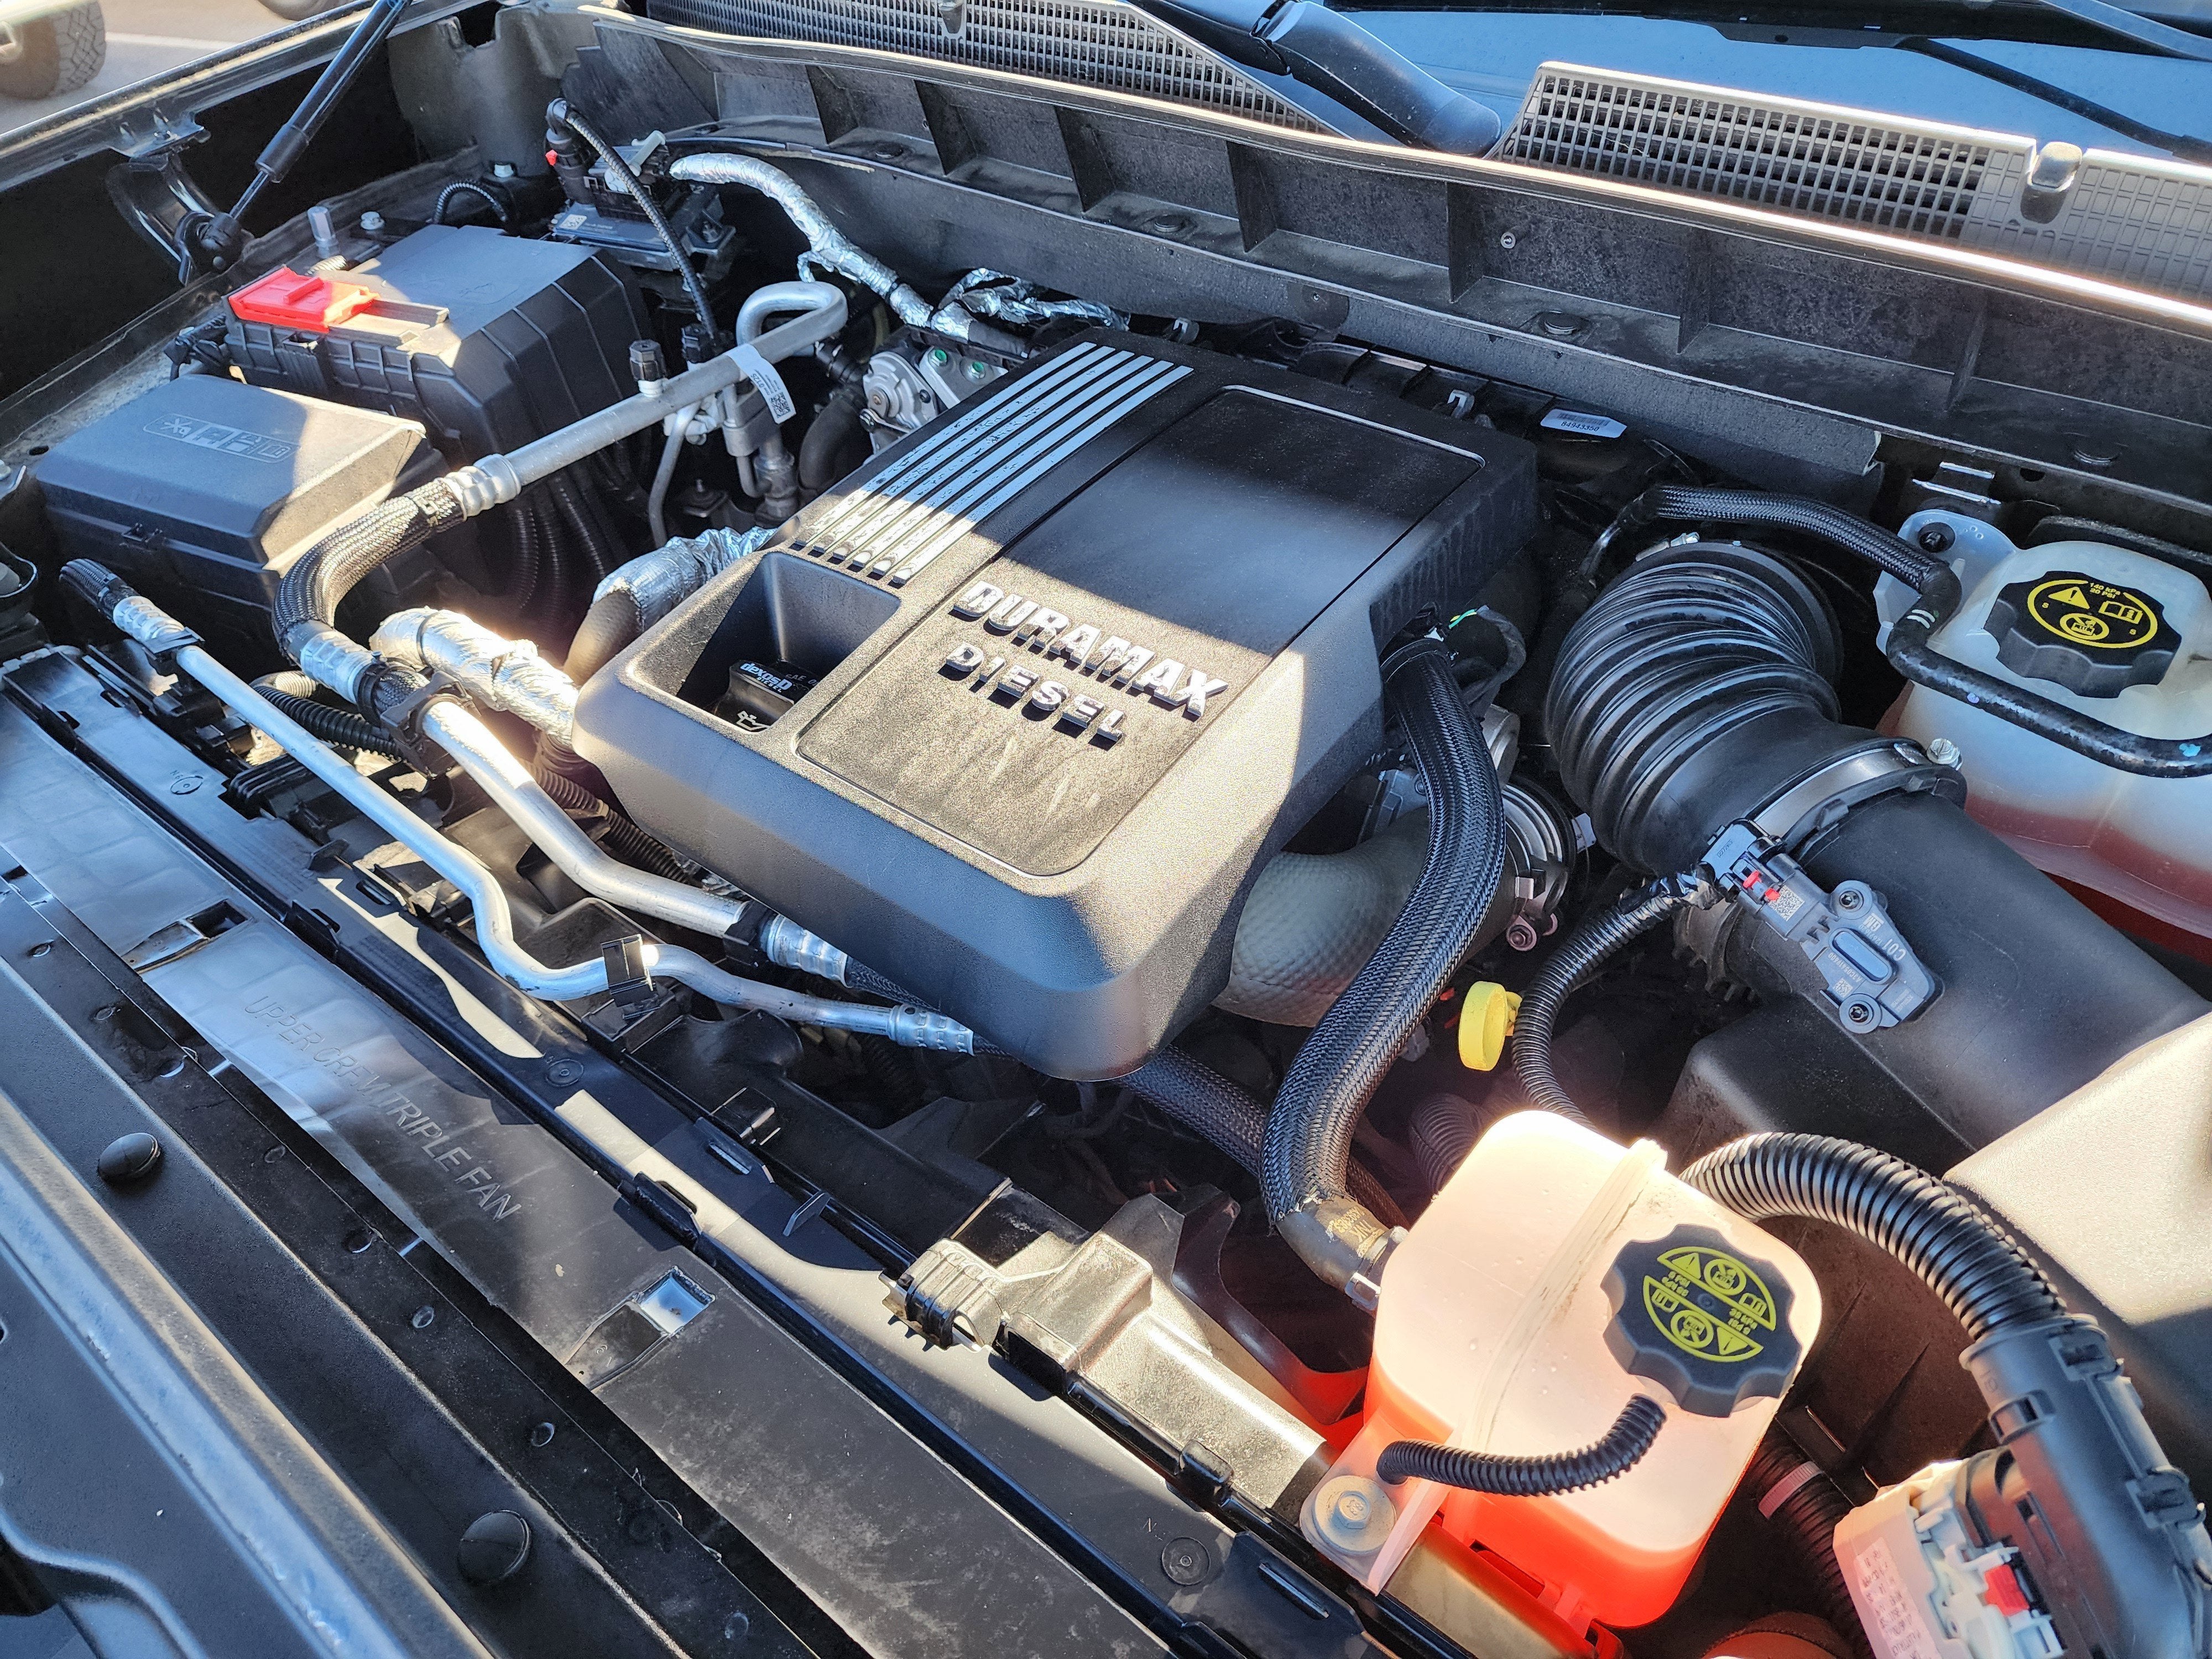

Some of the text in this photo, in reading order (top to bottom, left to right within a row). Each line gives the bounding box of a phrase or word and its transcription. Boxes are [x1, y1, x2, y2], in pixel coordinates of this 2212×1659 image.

[1561, 421, 1600, 431] 84943350
[2102, 591, 2116, 599] PSI
[2105, 587, 2121, 596] kPa
[953, 580, 1228, 717] DURAMAX
[757, 677, 782, 693] DIESEL
[785, 674, 807, 682] SAE
[945, 641, 1124, 742] DIESEL
[1863, 914, 1884, 932] GM
[245, 996, 326, 1051] UPPER
[379, 1092, 473, 1172] TRIPLE
[454, 1166, 522, 1223] FAN
